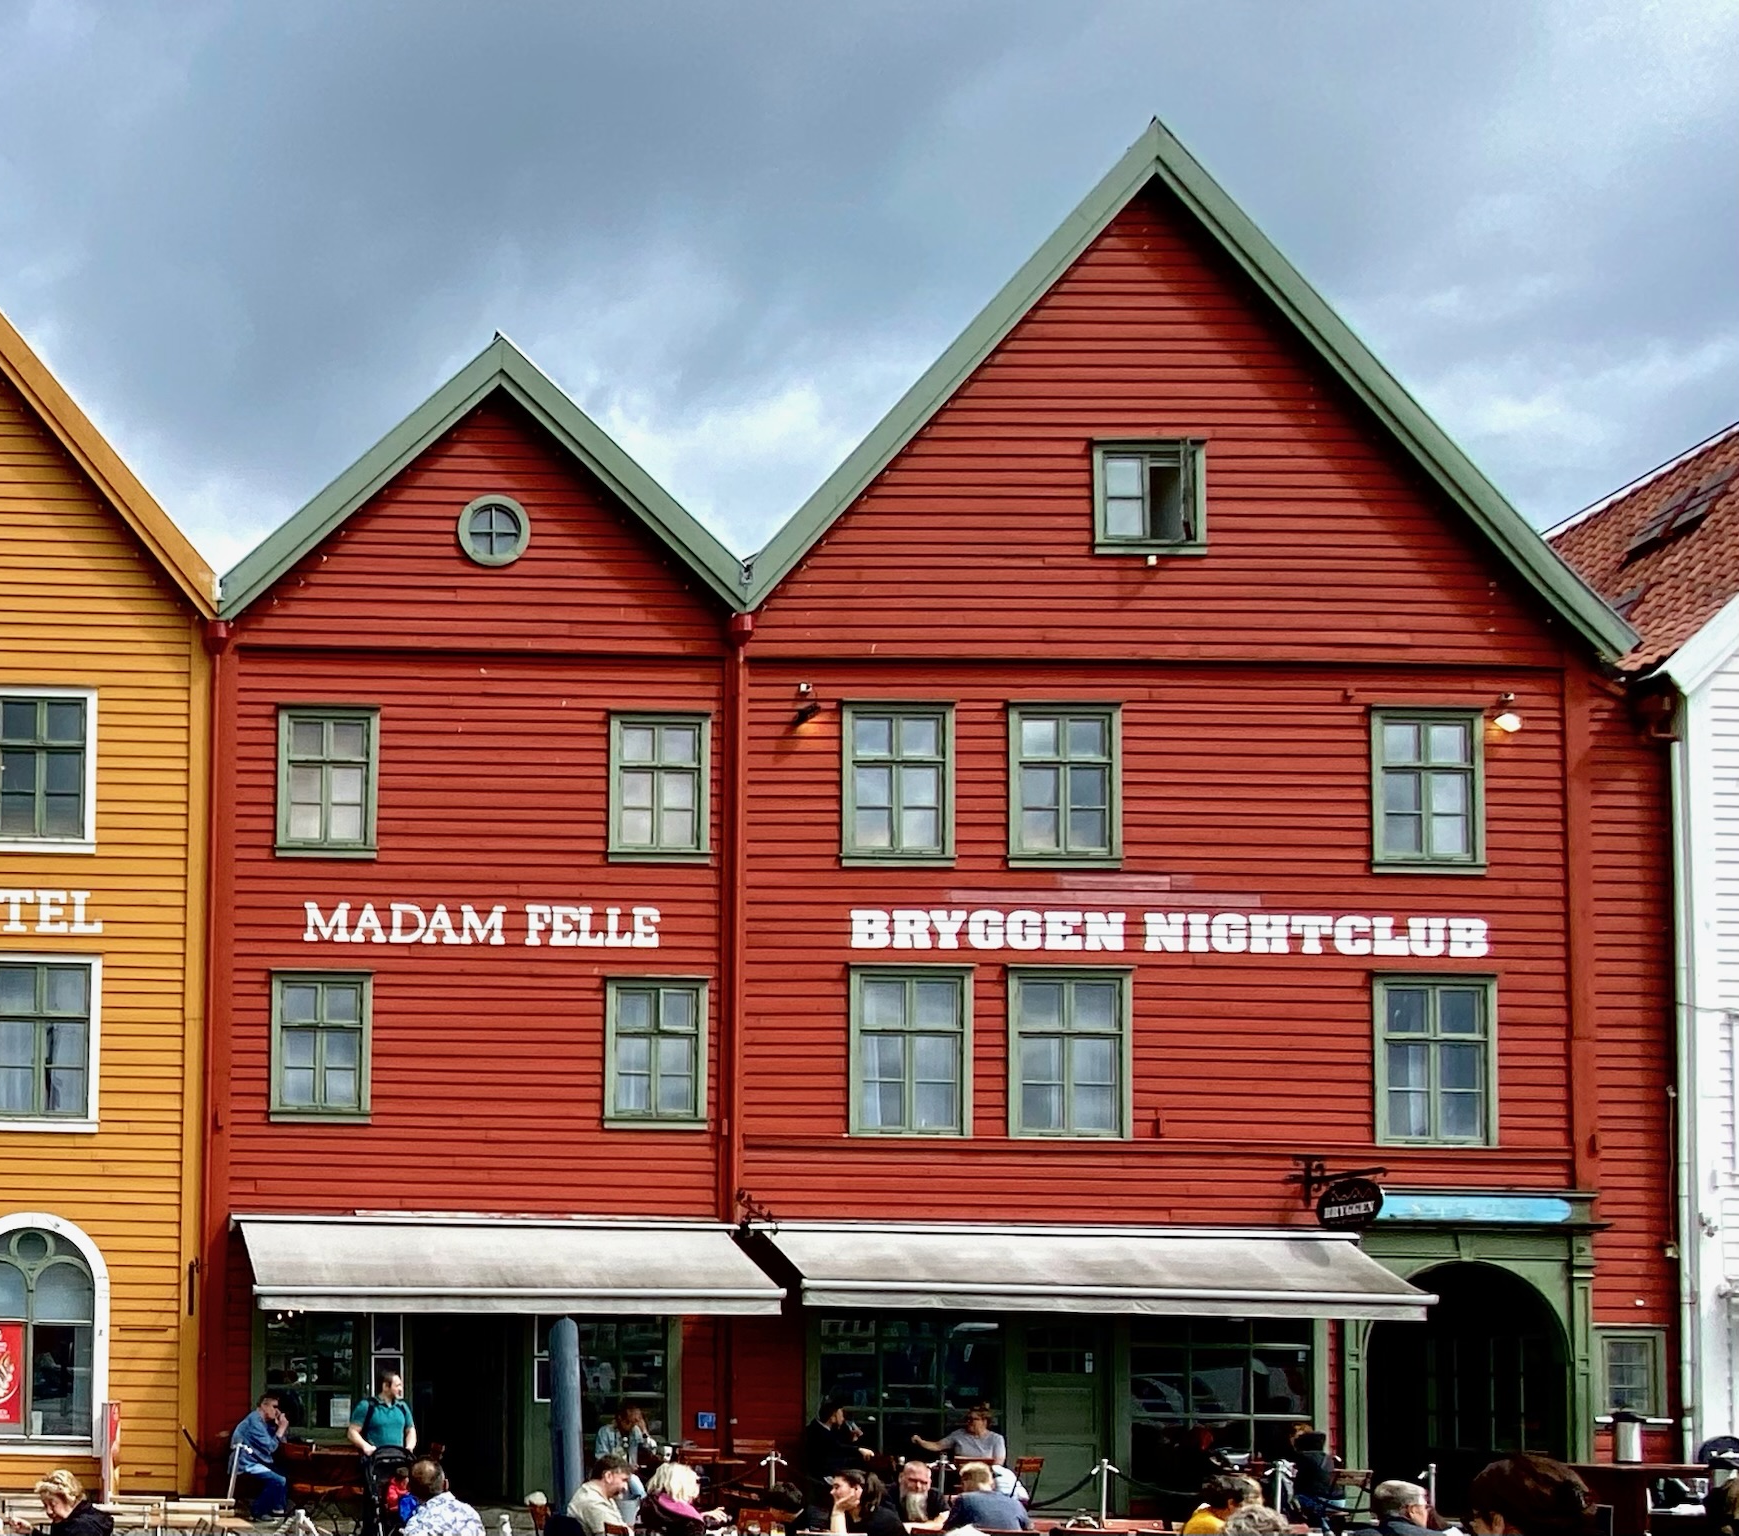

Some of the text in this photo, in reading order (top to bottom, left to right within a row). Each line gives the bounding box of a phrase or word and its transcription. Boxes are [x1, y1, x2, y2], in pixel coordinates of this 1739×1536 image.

[303, 901, 661, 948] MADAM FELLE
[849, 908, 1490, 959] BRYGGEN NIGHTCLUB
[1323, 1200, 1375, 1219] BRYGGEN
